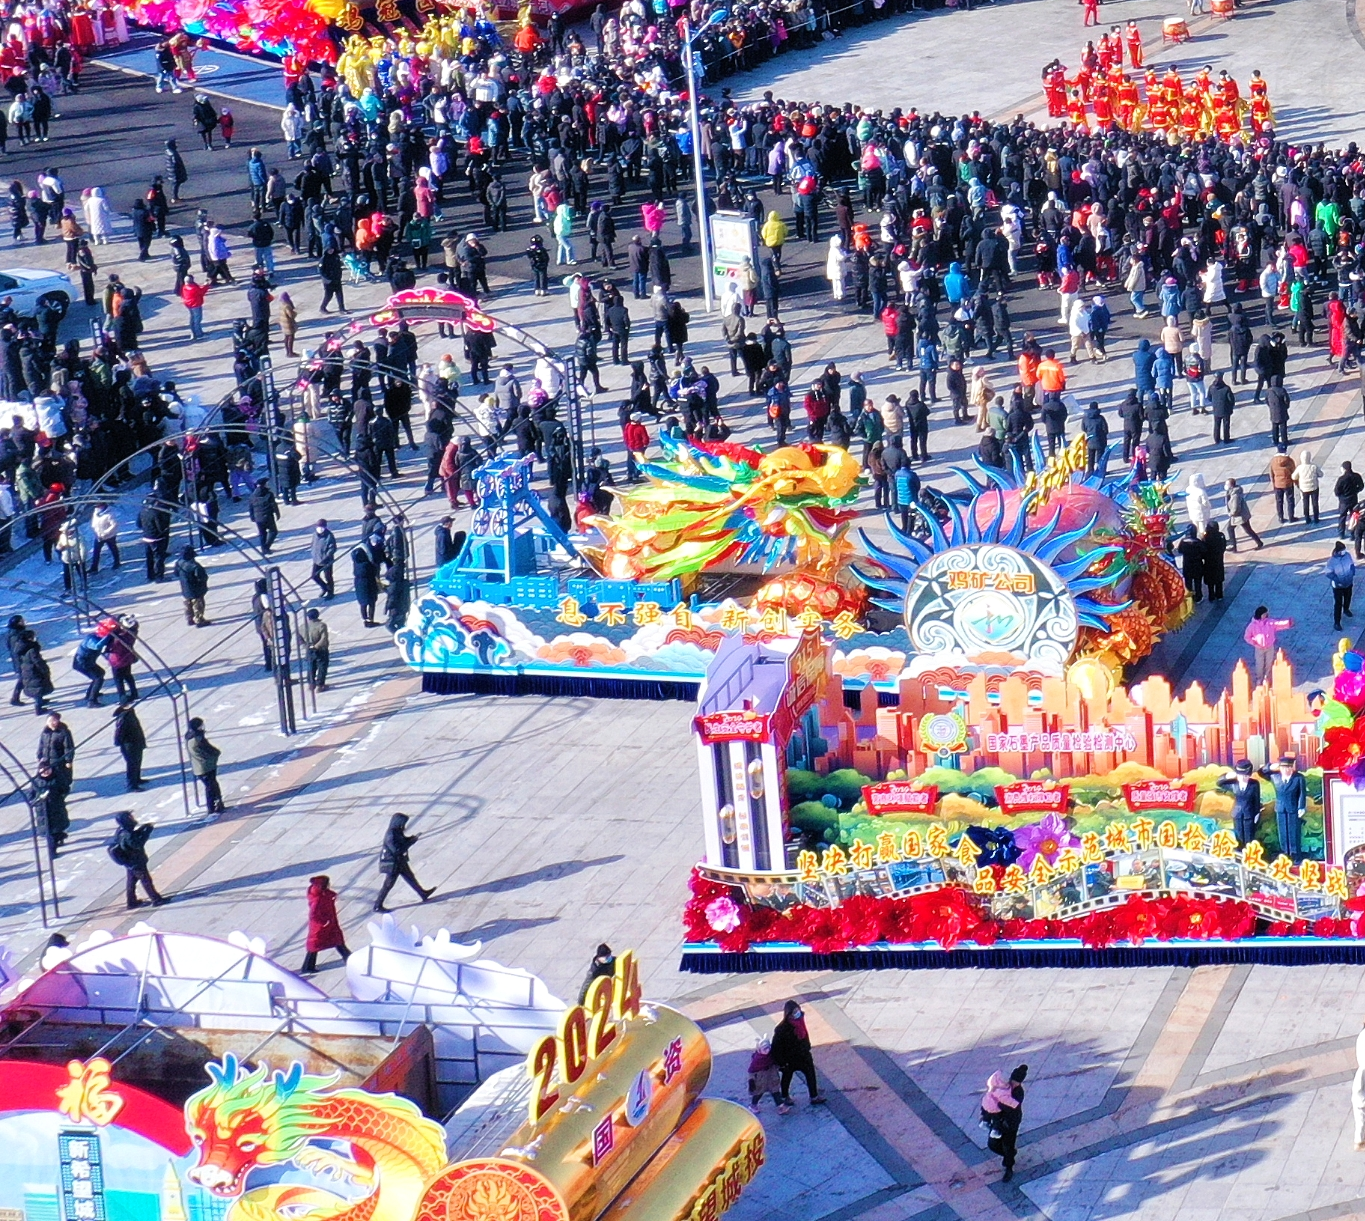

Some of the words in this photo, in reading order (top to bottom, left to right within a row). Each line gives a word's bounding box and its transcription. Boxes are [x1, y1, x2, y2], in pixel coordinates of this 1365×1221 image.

[947, 570, 1036, 593] 鸡矿公司
[986, 733, 1137, 753] 国家石墨产品质量检验检测中心
[527, 949, 643, 1127] 2024
[591, 1113, 615, 1167] 国
